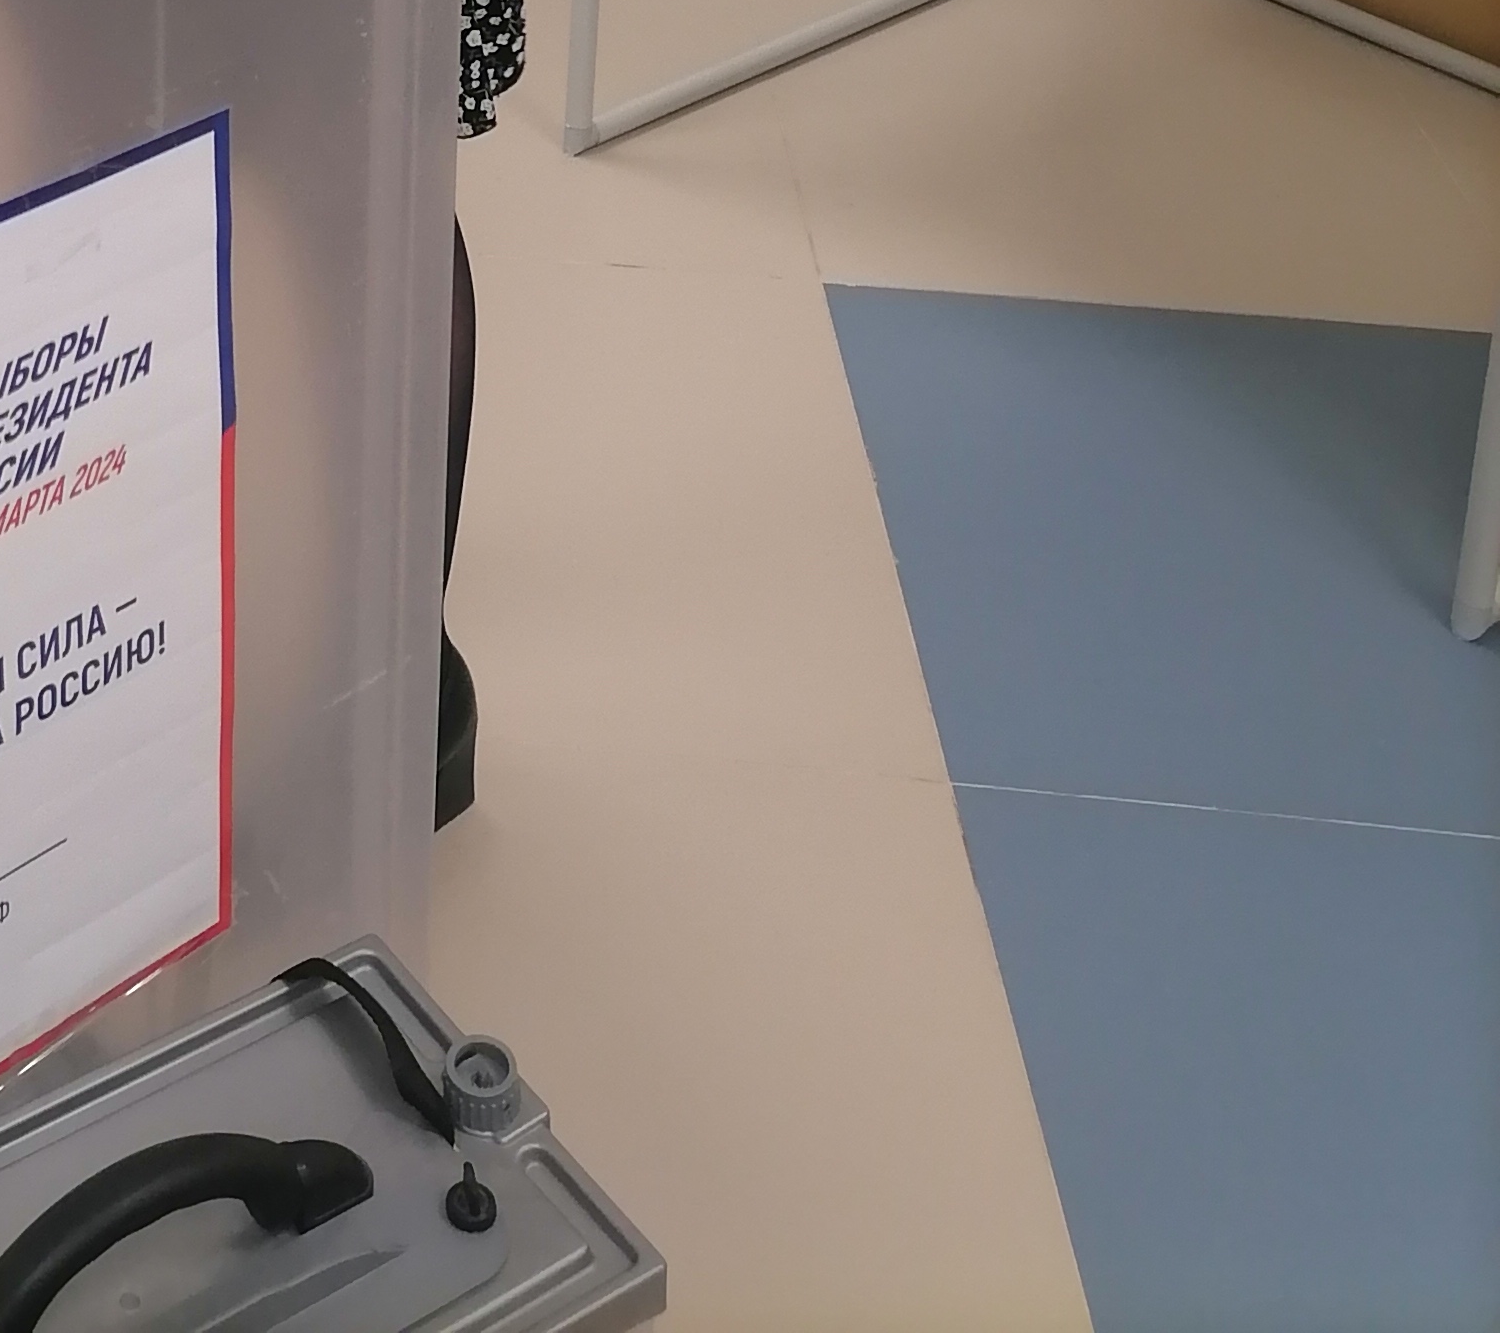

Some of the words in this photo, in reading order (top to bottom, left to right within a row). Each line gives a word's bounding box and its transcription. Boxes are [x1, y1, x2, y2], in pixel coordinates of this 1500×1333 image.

[69, 443, 128, 505] 2024
[14, 620, 168, 737] РОССИЮ!
[16, 603, 107, 680] СИЛА
